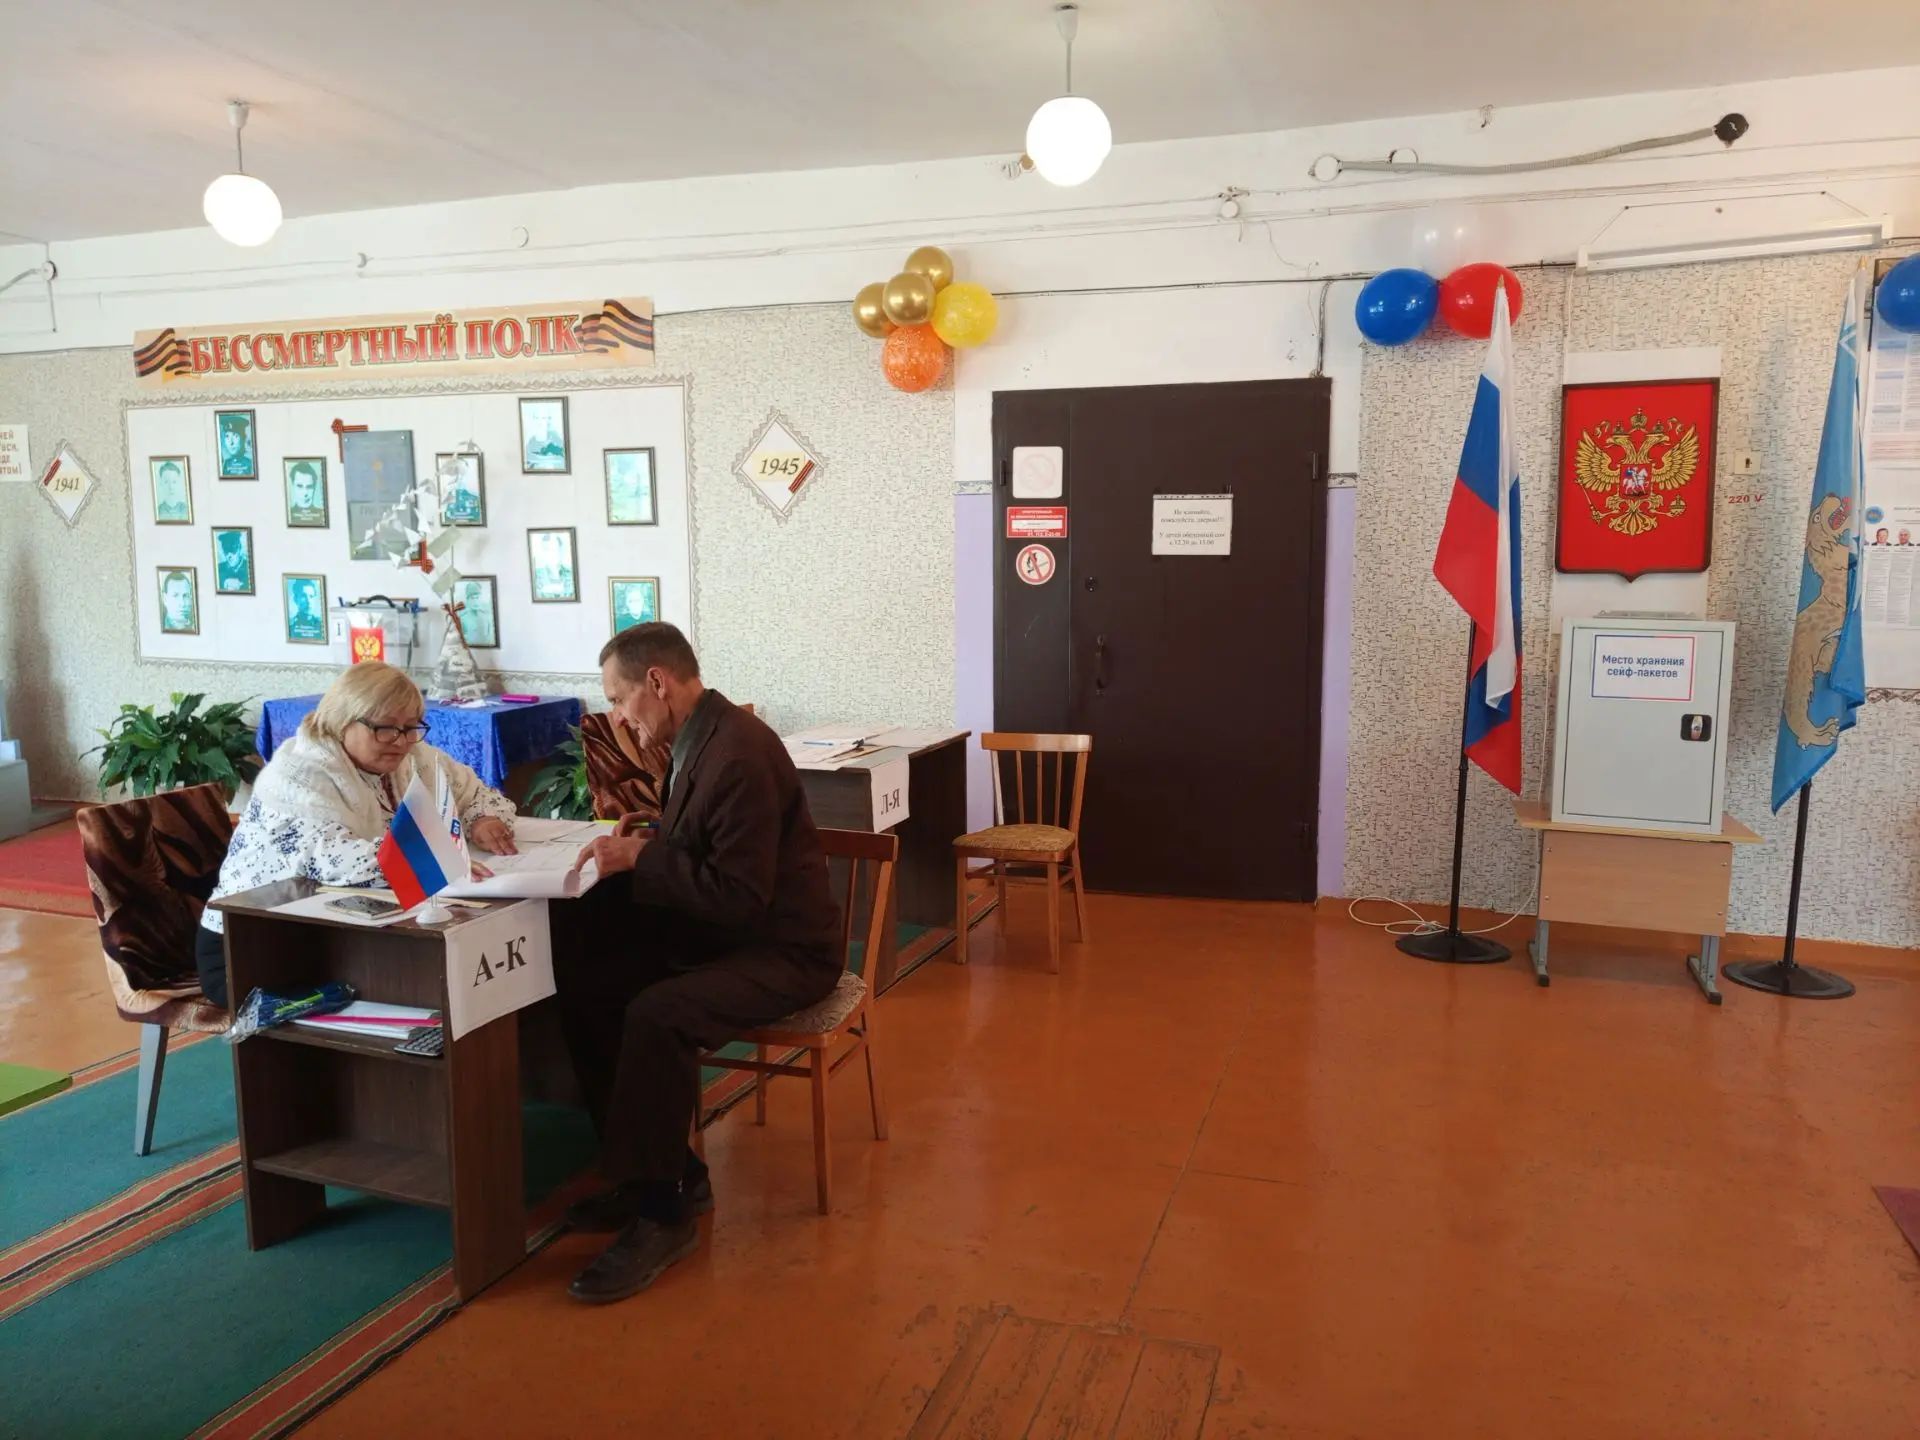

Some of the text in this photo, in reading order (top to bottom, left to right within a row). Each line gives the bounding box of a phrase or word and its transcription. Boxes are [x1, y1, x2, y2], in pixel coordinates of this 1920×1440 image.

[189, 314, 583, 373] БЕССМЕРТНЫЙ ПОЛК
[759, 458, 800, 475] 1945
[54, 478, 79, 492] 1941
[1728, 495, 1750, 503] 220
[1602, 655, 1685, 667] Место хранения
[1607, 667, 1678, 678] сейф-пакетов
[881, 788, 900, 815] Л-Я
[473, 936, 527, 987] А-К
